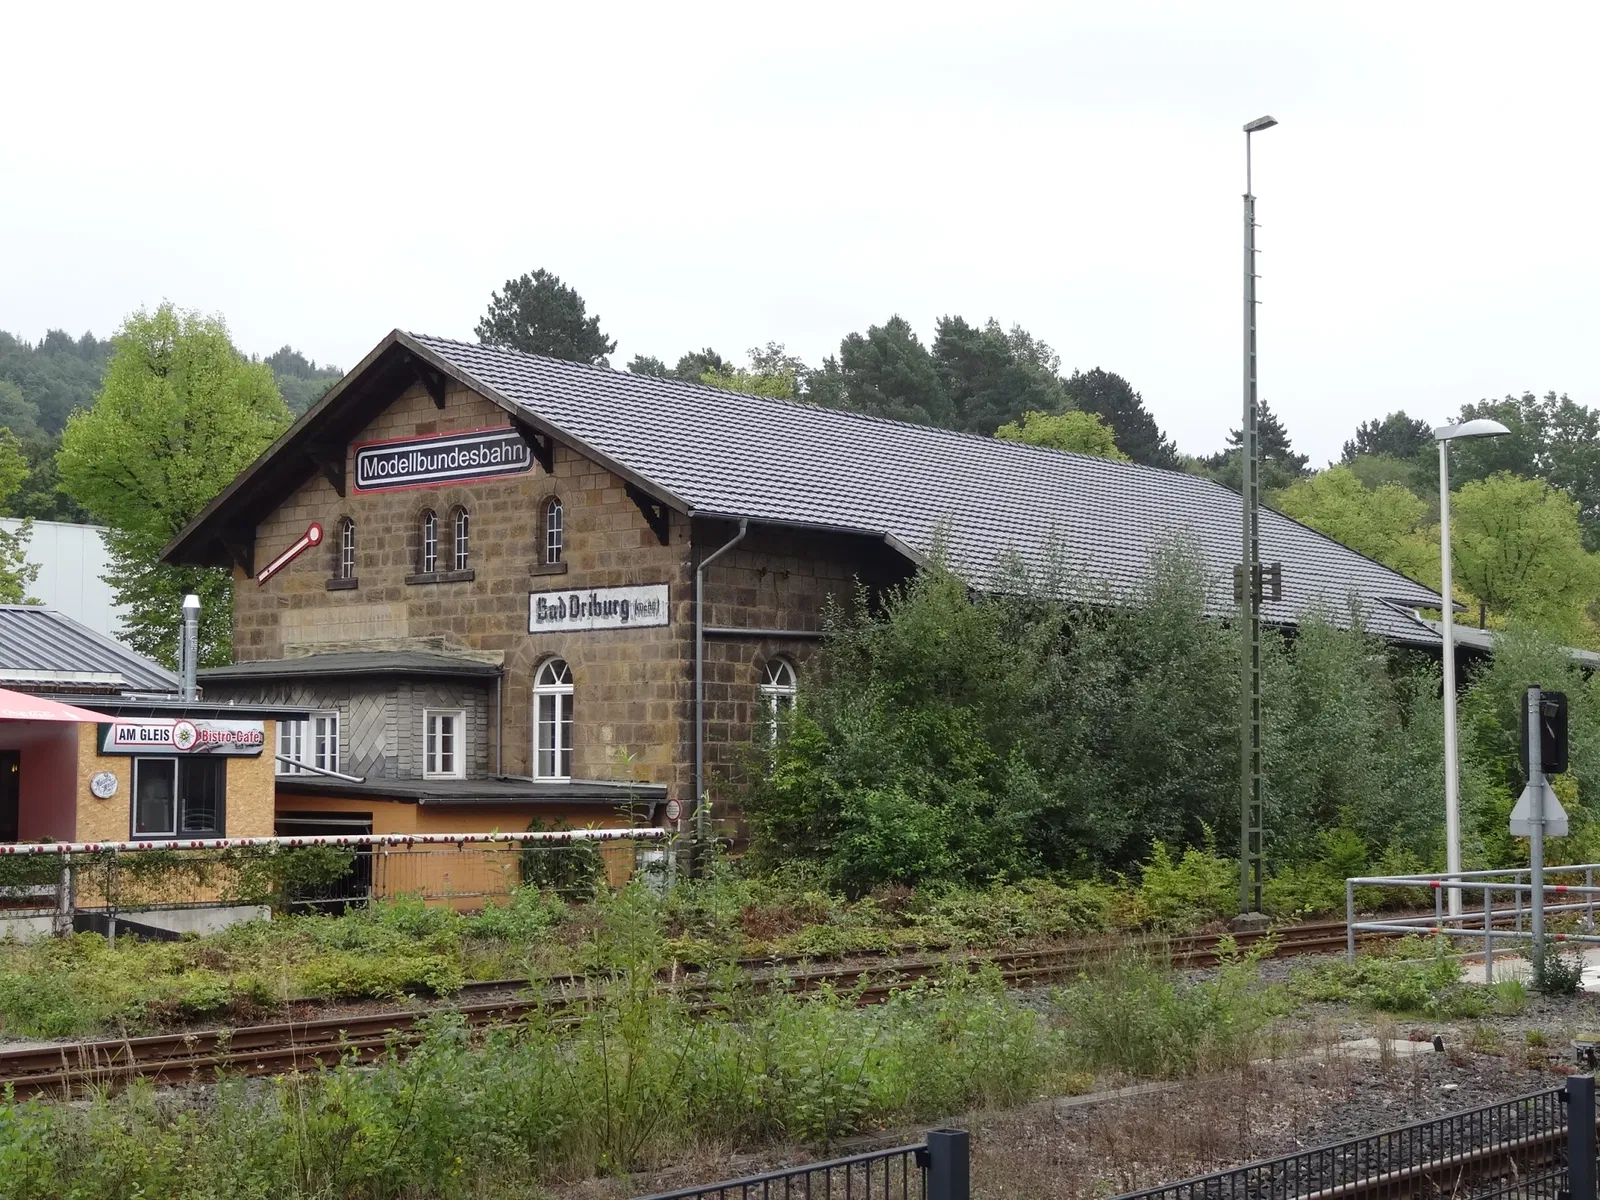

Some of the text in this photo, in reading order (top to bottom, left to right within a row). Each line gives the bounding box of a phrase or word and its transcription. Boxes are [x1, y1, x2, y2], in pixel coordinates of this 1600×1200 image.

[363, 441, 523, 478] Modellbundesbahn
[536, 596, 566, 622] Bad
[569, 593, 629, 622] Driburg
[119, 728, 170, 741] AM GLEIS
